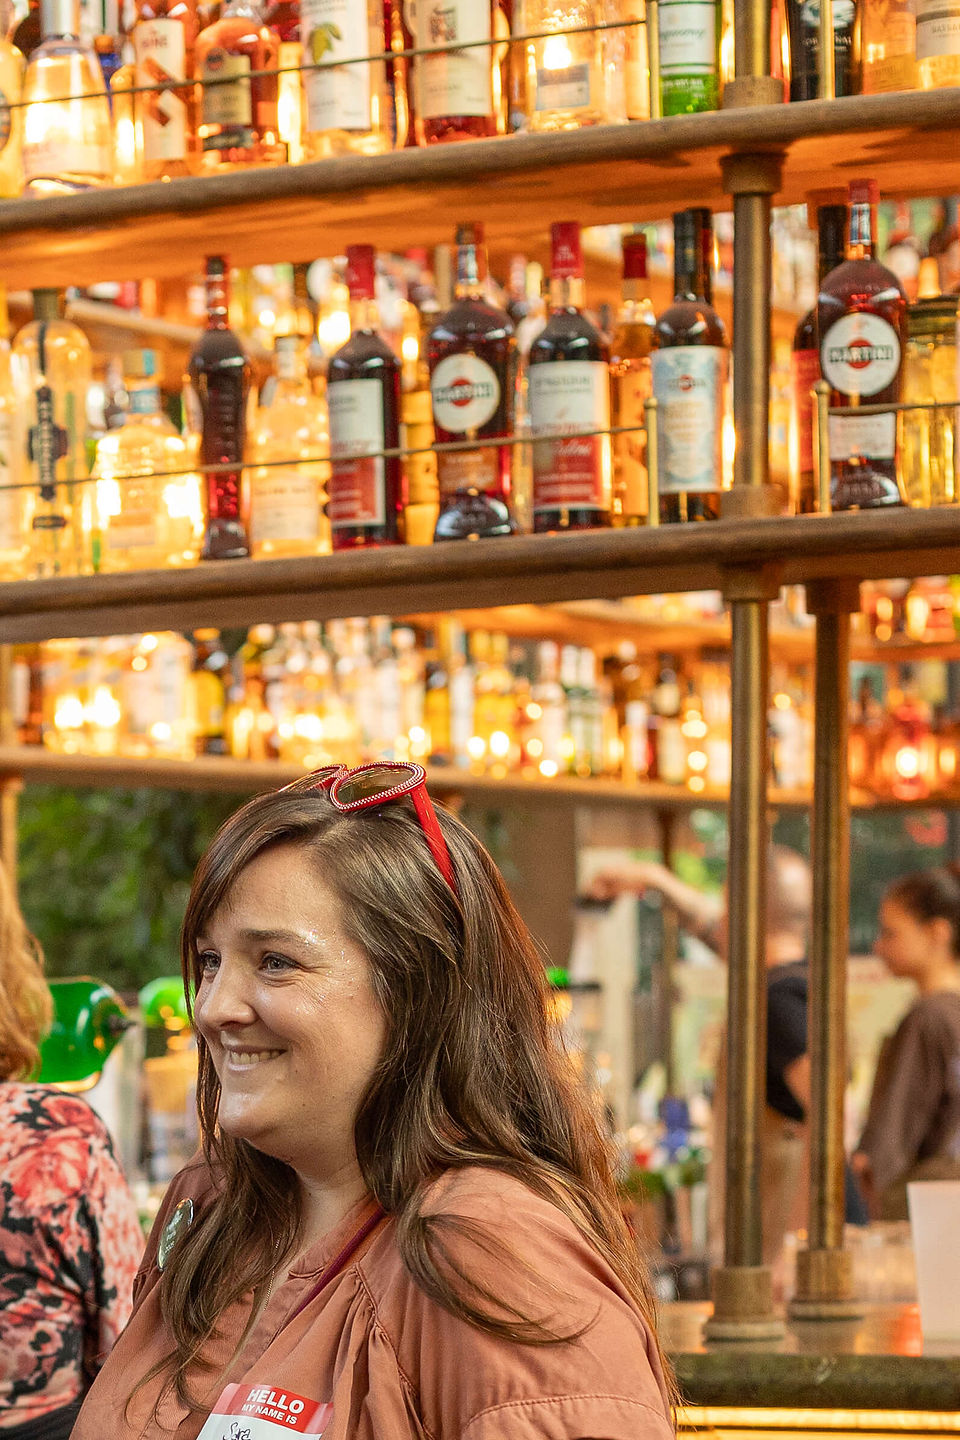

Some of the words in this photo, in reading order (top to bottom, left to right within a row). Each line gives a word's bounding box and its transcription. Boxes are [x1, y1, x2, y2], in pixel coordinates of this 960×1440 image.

[246, 1388, 305, 1414] HELLO
[241, 1403, 254, 1413] MY
[255, 1406, 284, 1421] NAME
[285, 1414, 298, 1425] IS
